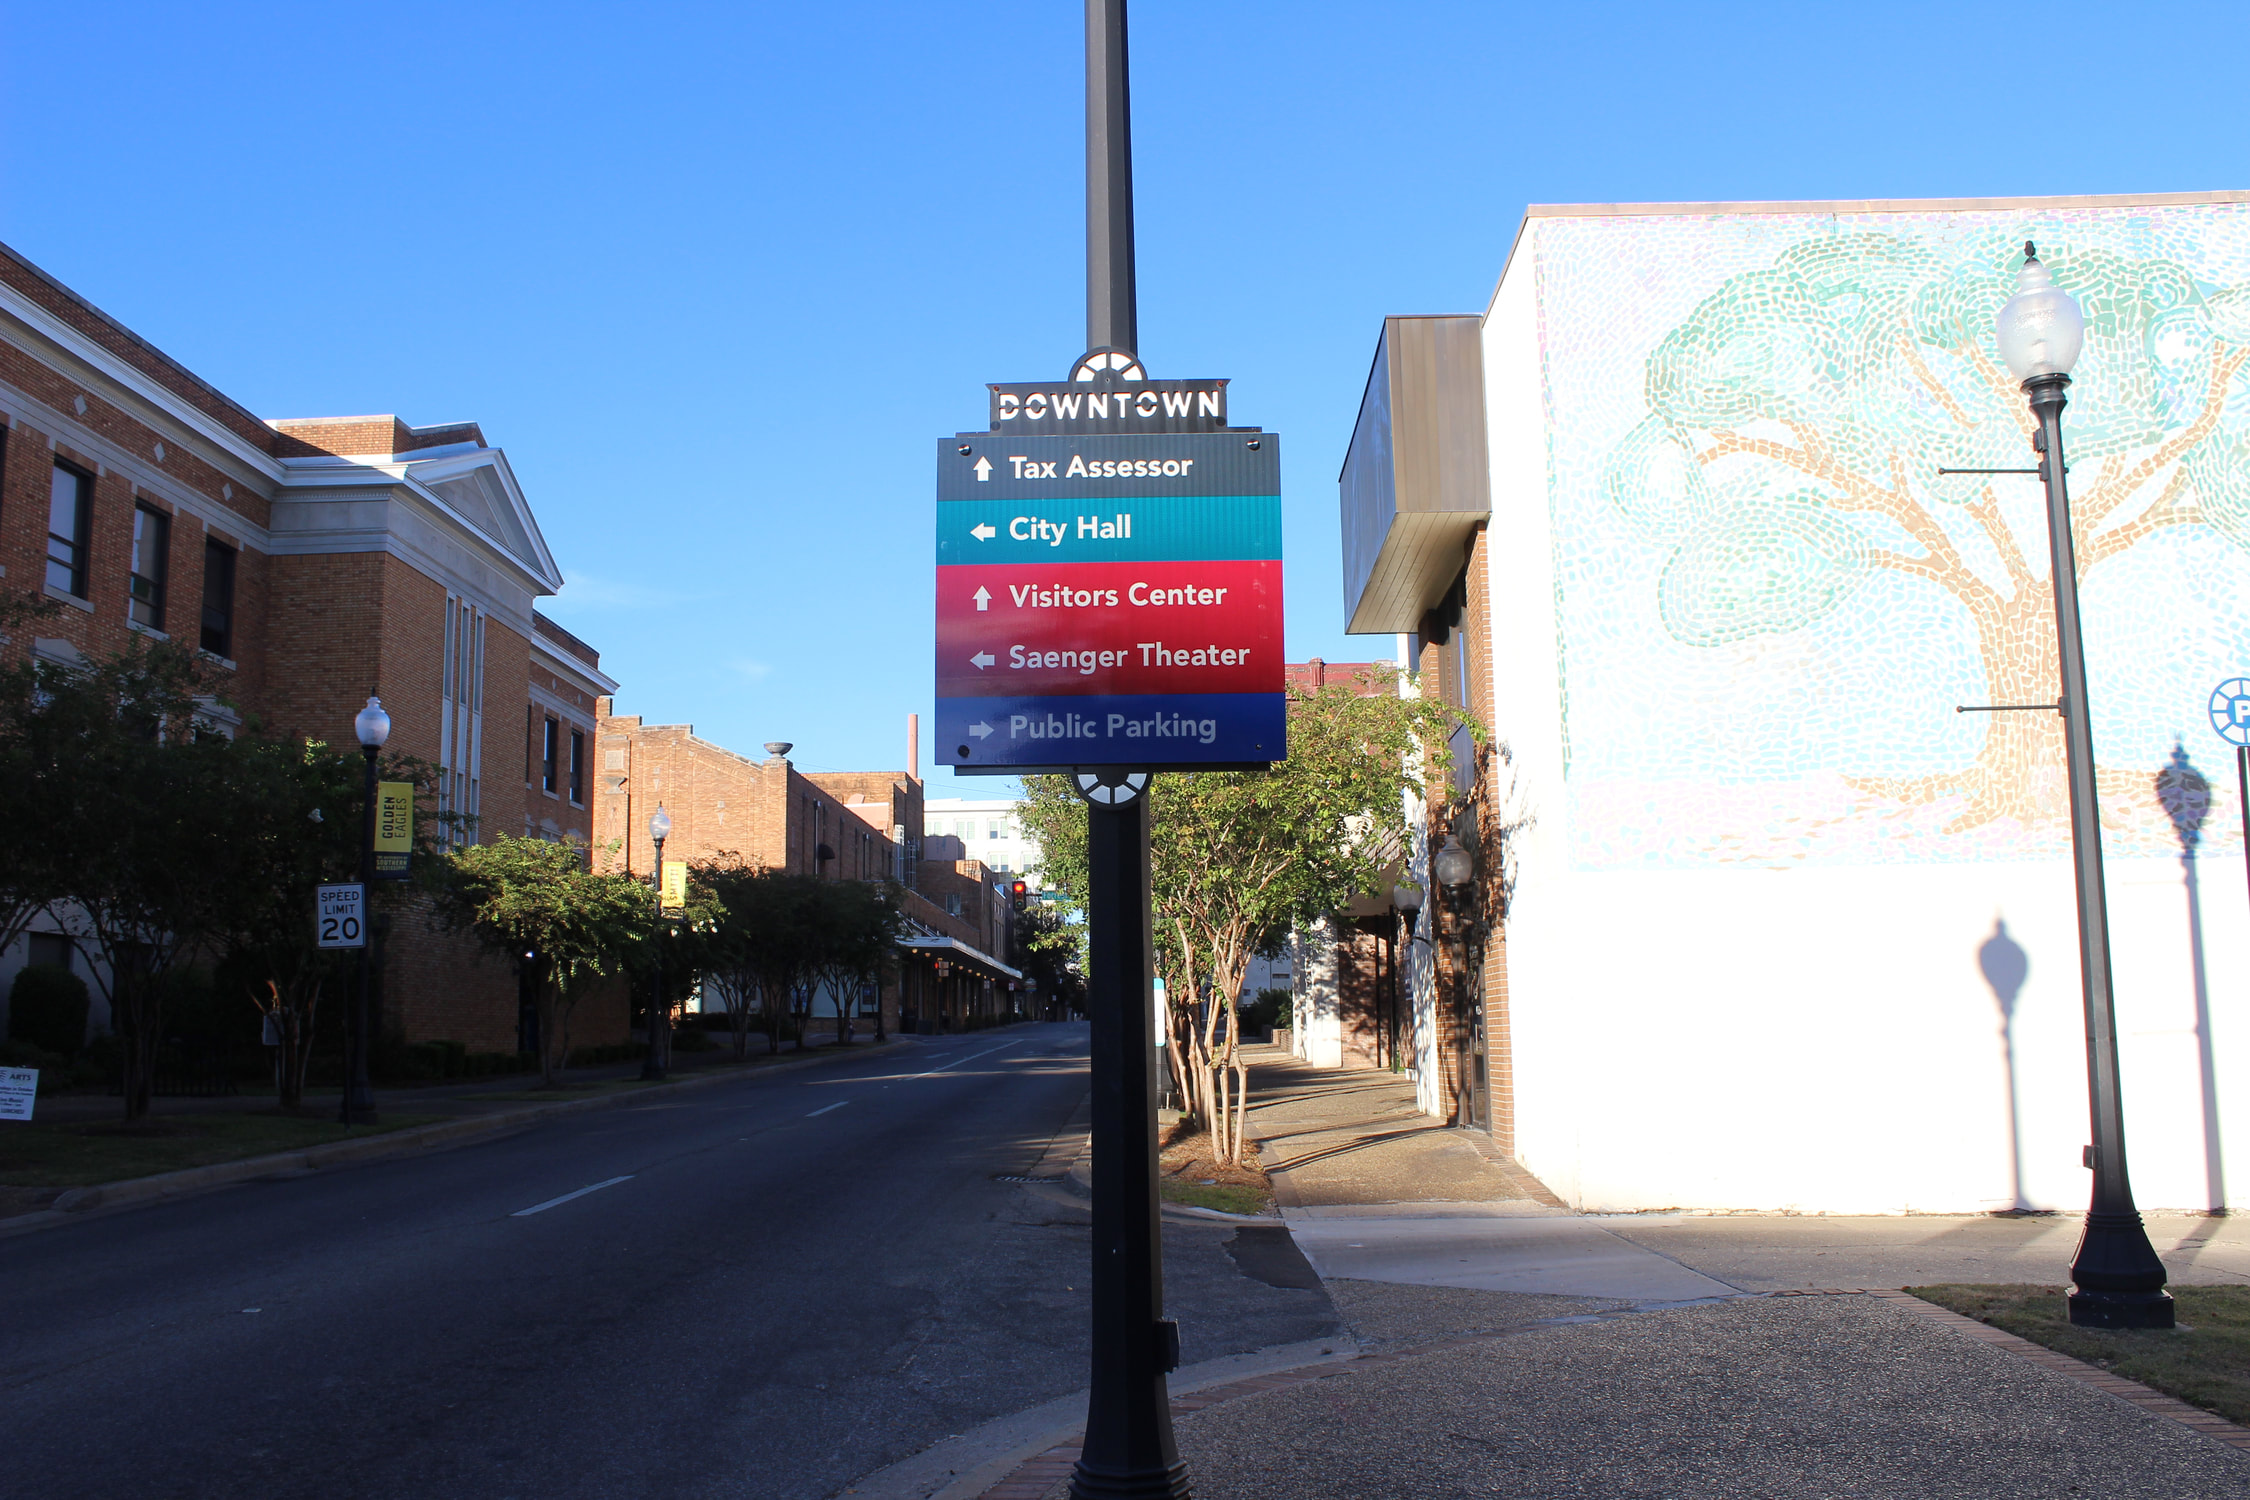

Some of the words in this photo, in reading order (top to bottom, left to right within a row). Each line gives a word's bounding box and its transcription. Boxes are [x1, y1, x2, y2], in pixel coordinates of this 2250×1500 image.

[999, 391, 1219, 420] DOWNTOWN
[1009, 457, 1057, 479] Tax
[1066, 456, 1193, 478] Assessor
[1009, 515, 1067, 546] City
[1078, 514, 1131, 538] Hall
[1009, 584, 1118, 608] Visitors
[1128, 582, 1227, 606] Center
[1010, 645, 1128, 674] Saenger
[1137, 642, 1250, 667] Theater
[2234, 700, 2250, 723] P
[1010, 715, 1097, 739] Public
[1107, 712, 1216, 744] Parking
[382, 797, 395, 839] GOLDEN
[394, 798, 407, 838] EAGLES
[321, 891, 360, 902] SPEED
[325, 904, 355, 915] LIMIT
[322, 917, 360, 941] 20
